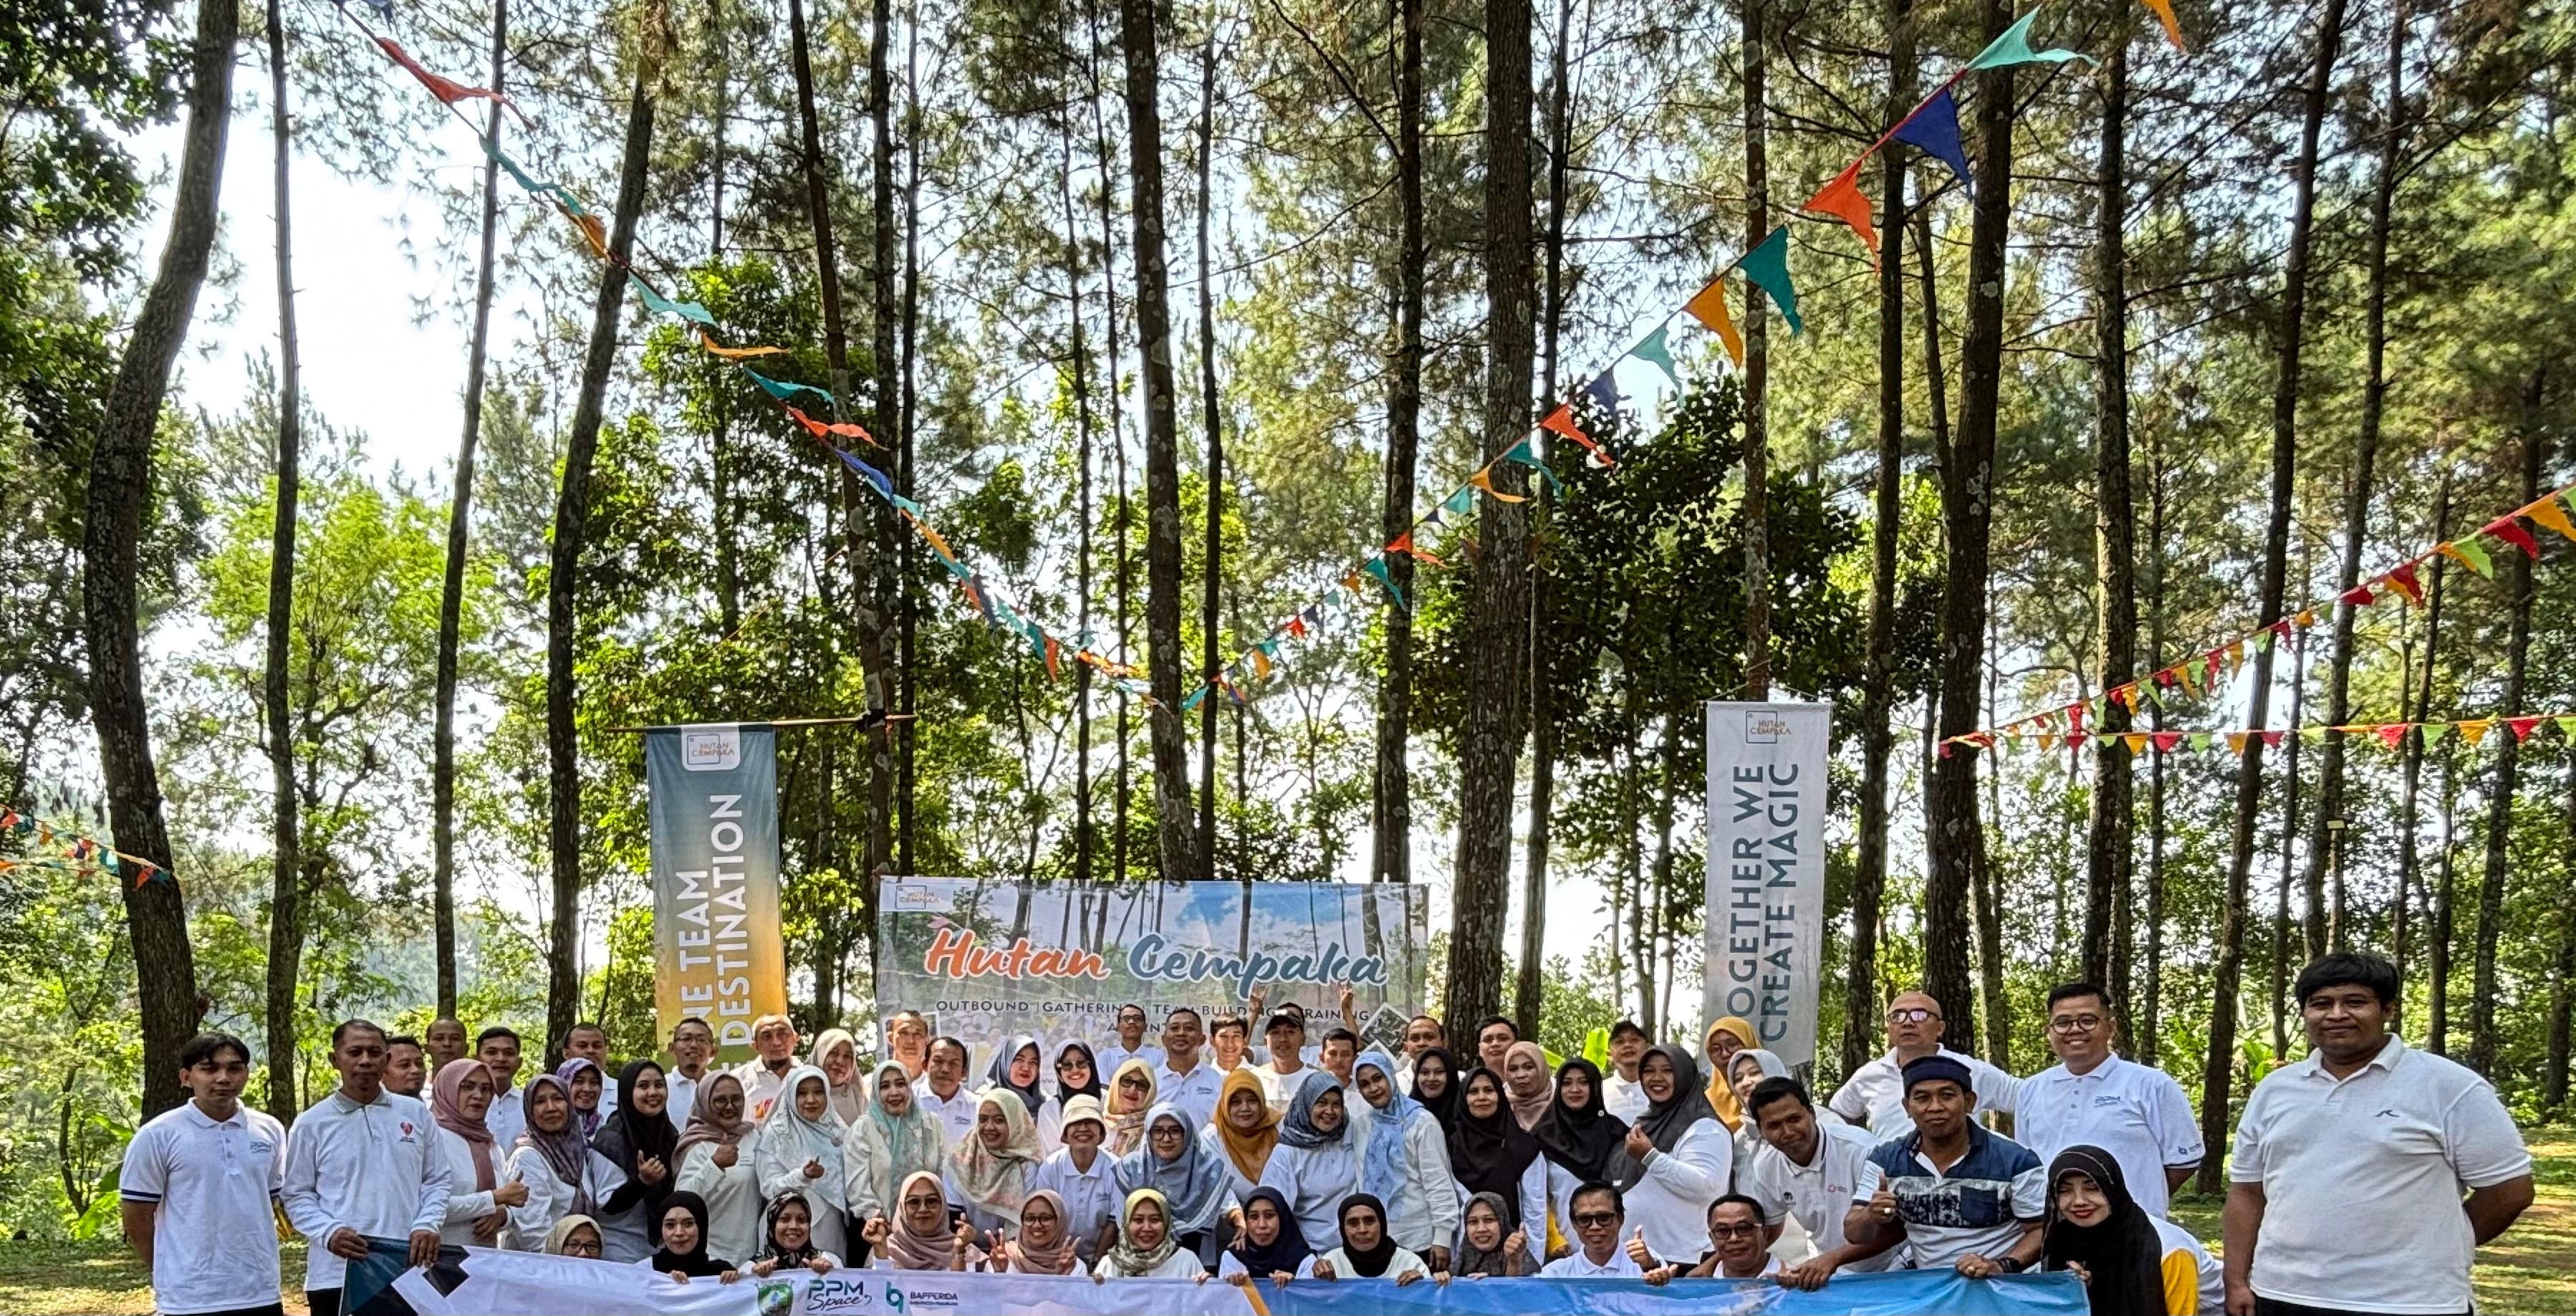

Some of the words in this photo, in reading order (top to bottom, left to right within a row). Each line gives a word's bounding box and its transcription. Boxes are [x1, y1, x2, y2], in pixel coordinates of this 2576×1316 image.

[1733, 765, 1764, 823] WE
[1766, 764, 1799, 888] MAGIC
[675, 870, 712, 972] TEAM
[710, 794, 752, 1046] DESTINATION
[927, 930, 1110, 979] Hutan
[1128, 933, 1387, 1000] Cempaka
[1726, 837, 1763, 1017] OGETHER
[936, 1000, 1029, 1012] OUTBOUND
[1042, 1002, 1120, 1014] GATHERIN
[1759, 904, 1795, 1042] CREATE
[807, 1279, 864, 1299] PPM
